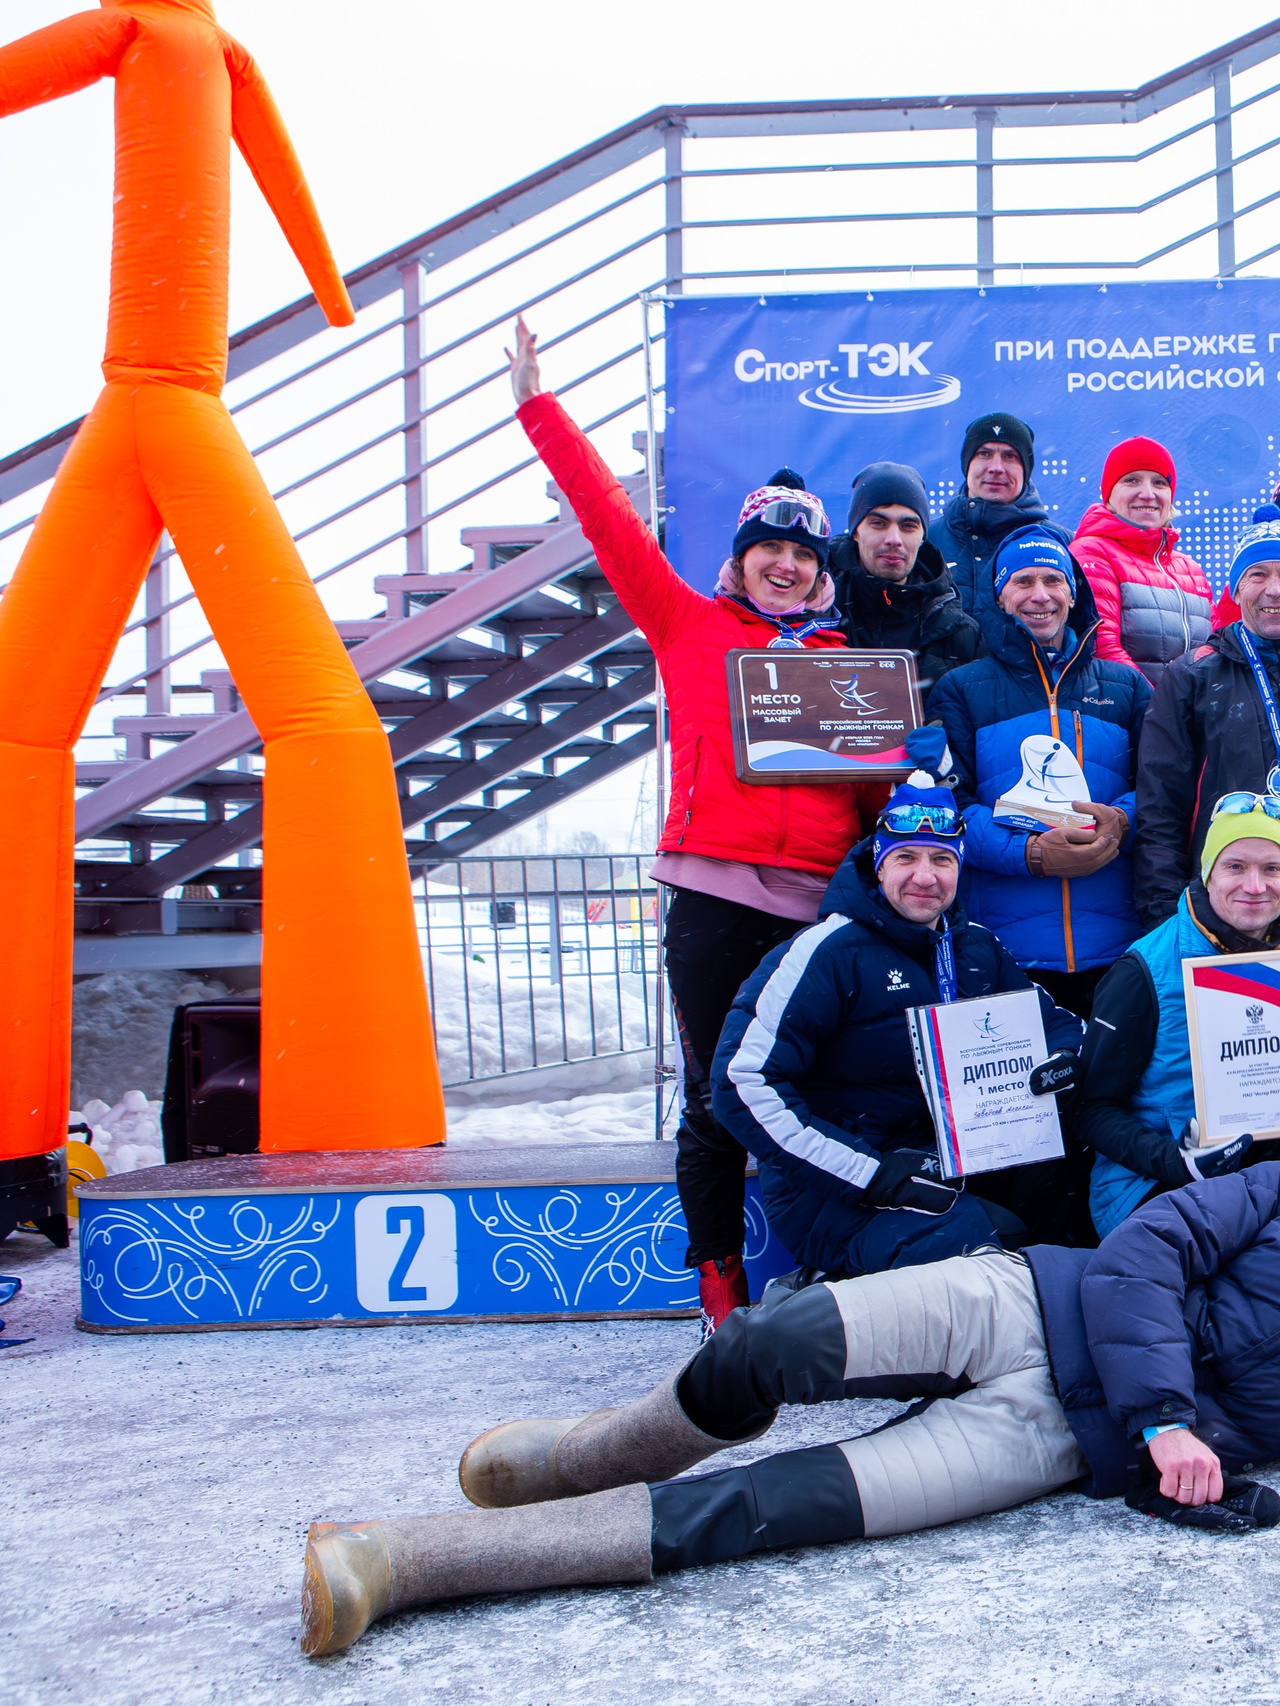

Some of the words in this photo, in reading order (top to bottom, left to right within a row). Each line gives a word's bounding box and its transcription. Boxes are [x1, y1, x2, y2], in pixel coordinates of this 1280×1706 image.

[995, 340, 1054, 361] ПРИ
[1067, 333, 1257, 360] ПОДДЕРЖКЕ
[1067, 361, 1264, 393] РОССИЙСКОЙ
[764, 662, 778, 690] 1
[751, 694, 801, 704] МЕСТО
[1089, 697, 1114, 705] Columbia
[887, 982, 910, 992] KELME
[963, 1055, 1034, 1085] ДИПЛОМ
[978, 1086, 984, 1096] 1
[988, 1081, 1025, 1095] место
[976, 1093, 1030, 1109] НАГРАЖДАЕТСЯ
[386, 1206, 427, 1302] 2
